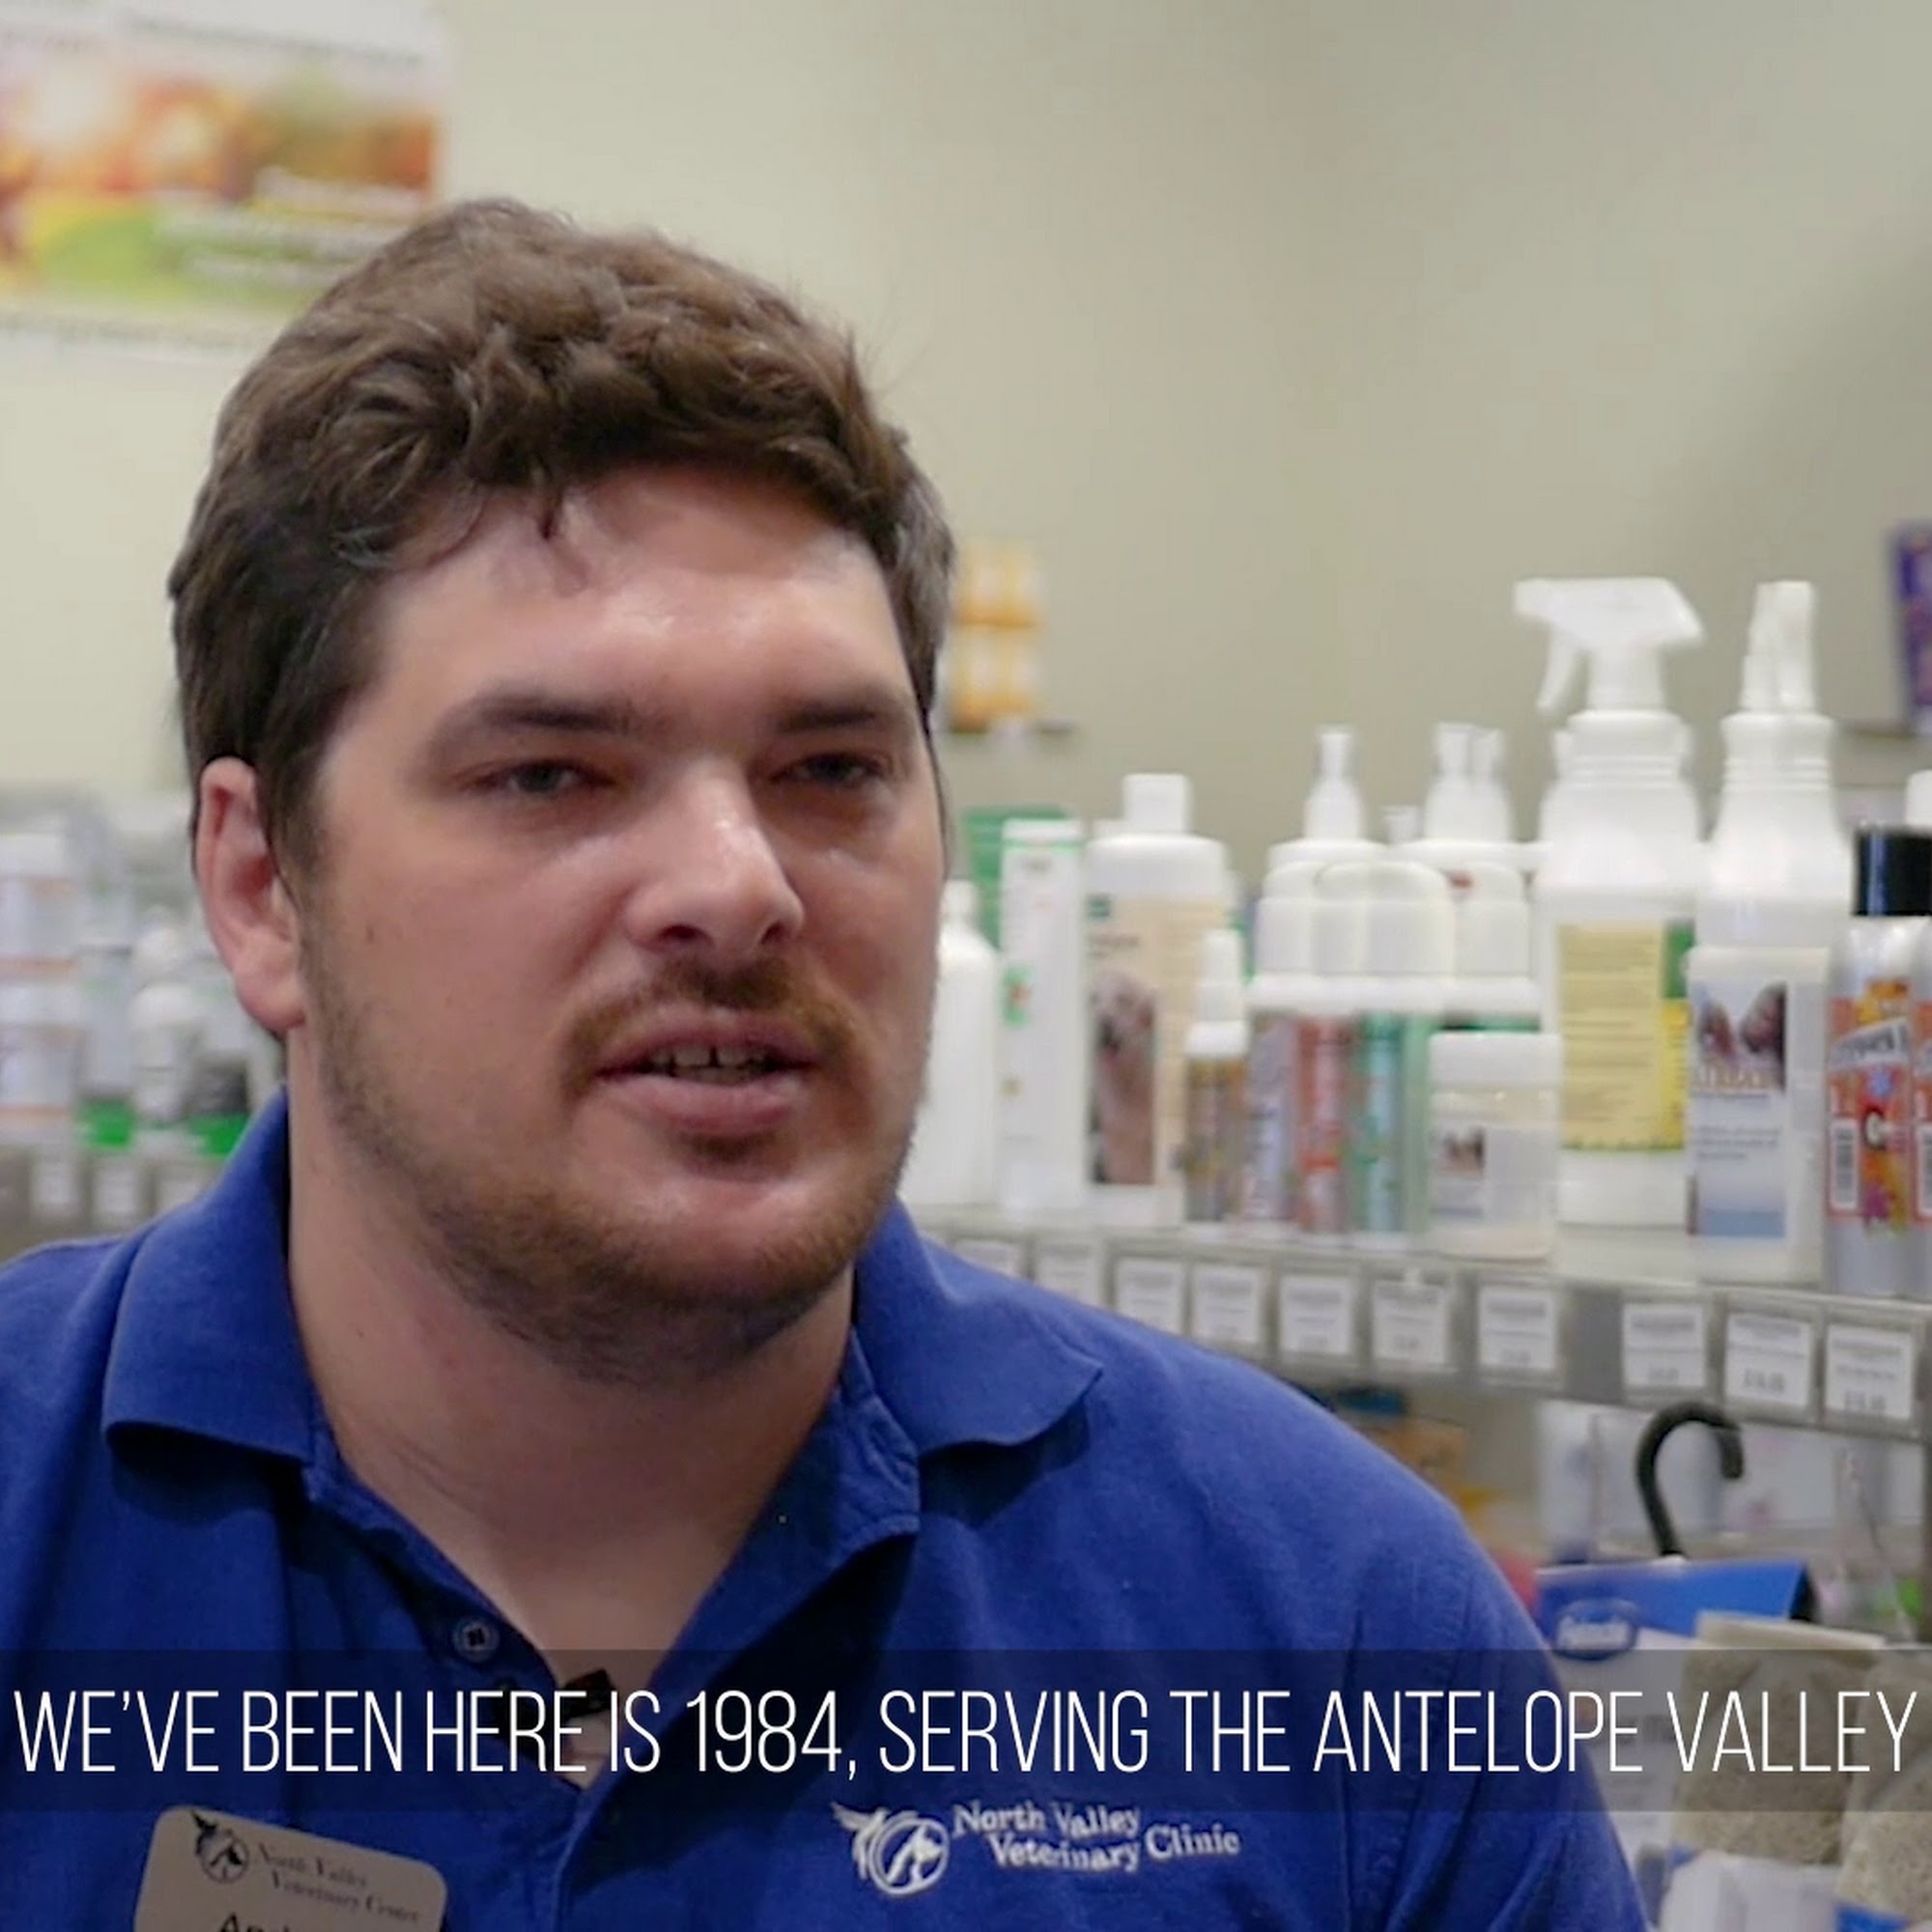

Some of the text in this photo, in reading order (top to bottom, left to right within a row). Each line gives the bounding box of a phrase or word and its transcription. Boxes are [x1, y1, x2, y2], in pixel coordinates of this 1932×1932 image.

[952, 1801, 1140, 1839] North Valley
[987, 1823, 1240, 1872] Veterinary Clinic
